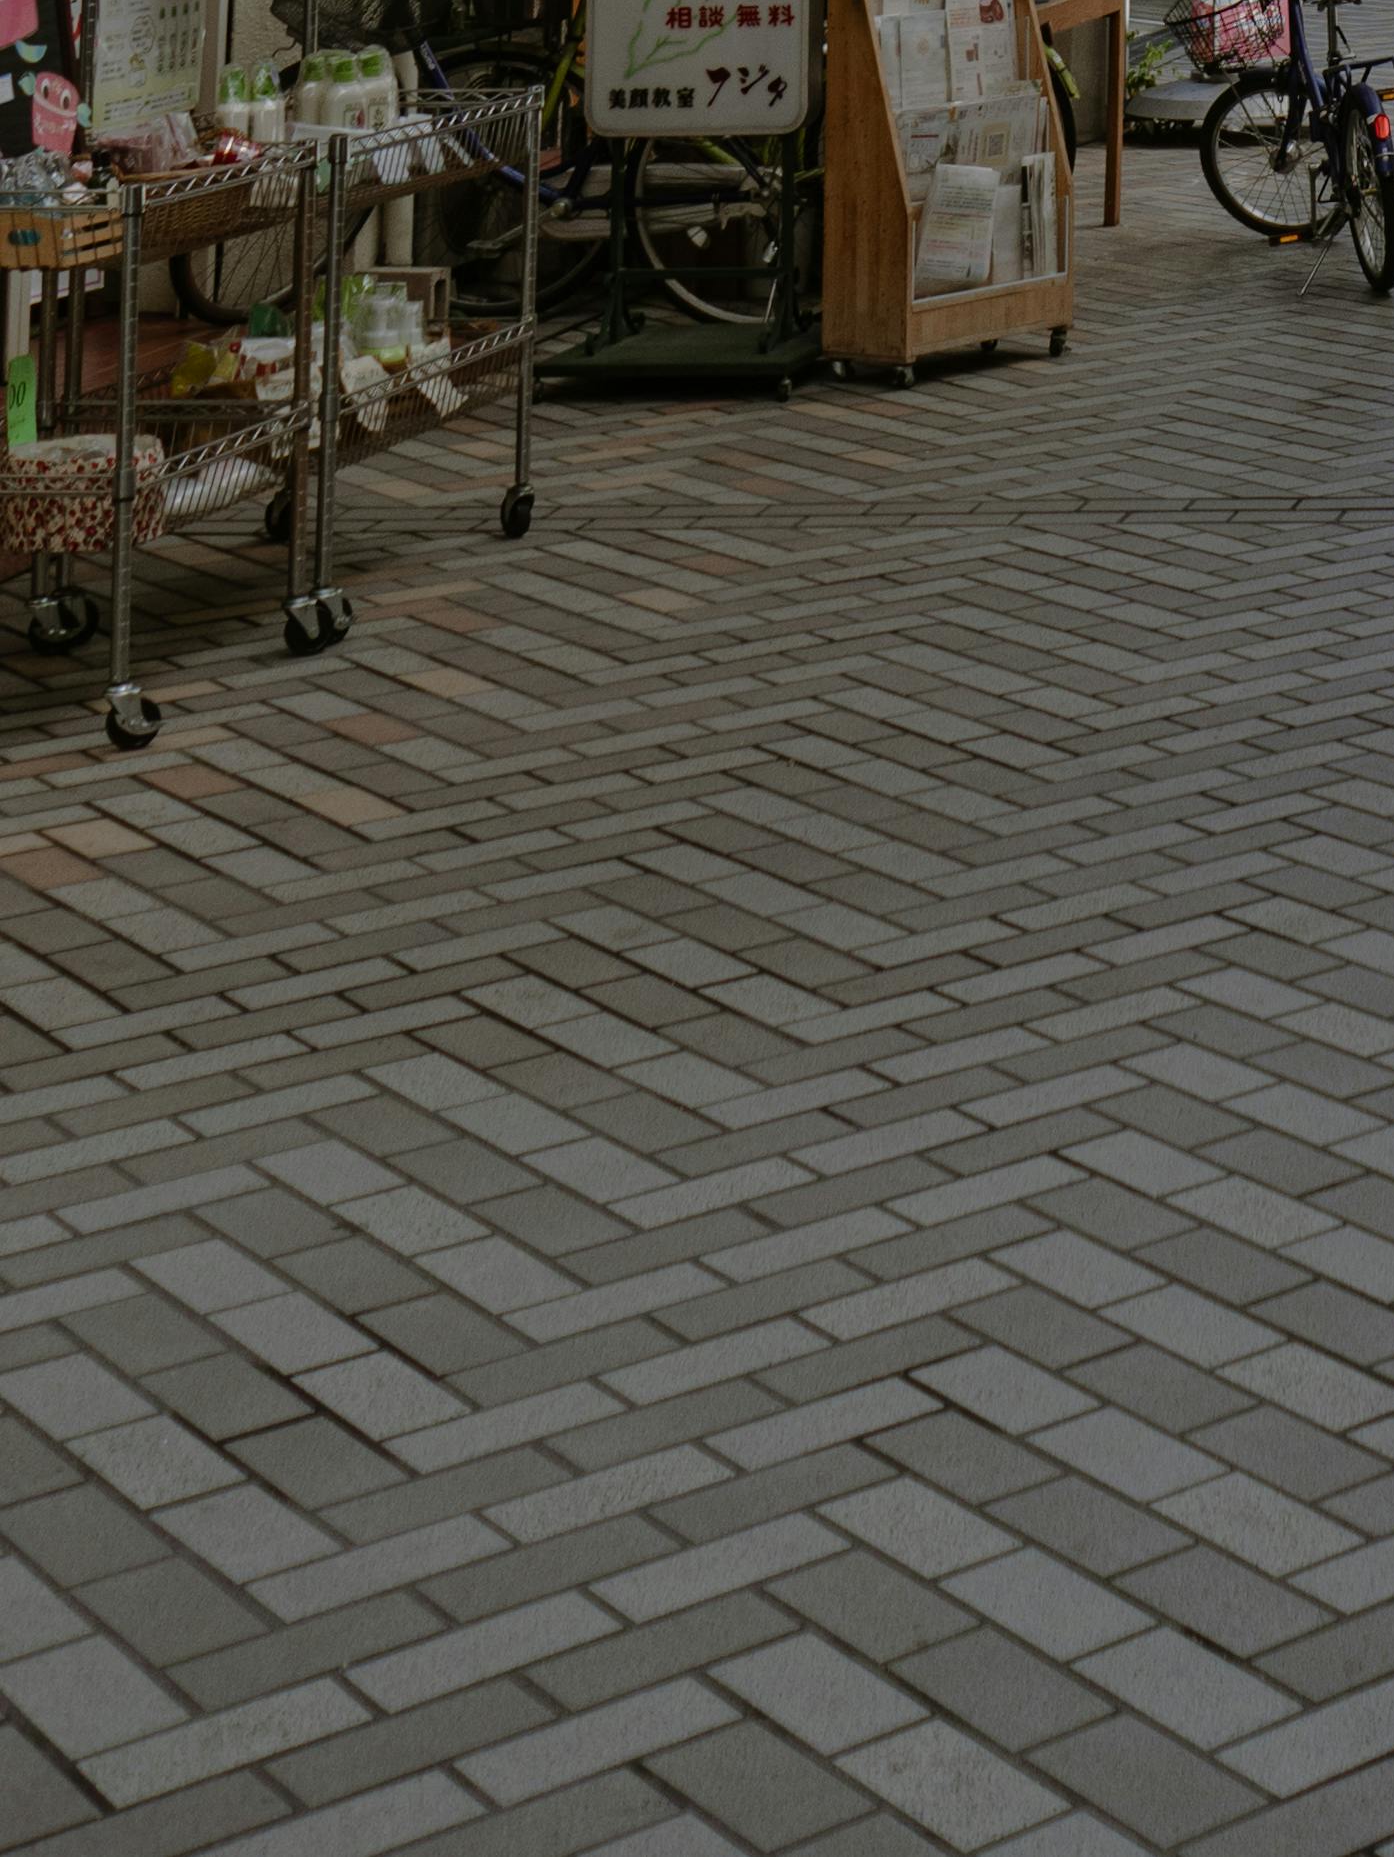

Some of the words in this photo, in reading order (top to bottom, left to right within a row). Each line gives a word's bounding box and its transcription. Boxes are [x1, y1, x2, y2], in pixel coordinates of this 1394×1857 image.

[664, 3, 796, 30] 相談無料
[607, 87, 696, 110] 美顔教室
[705, 64, 789, 108] フジタ
